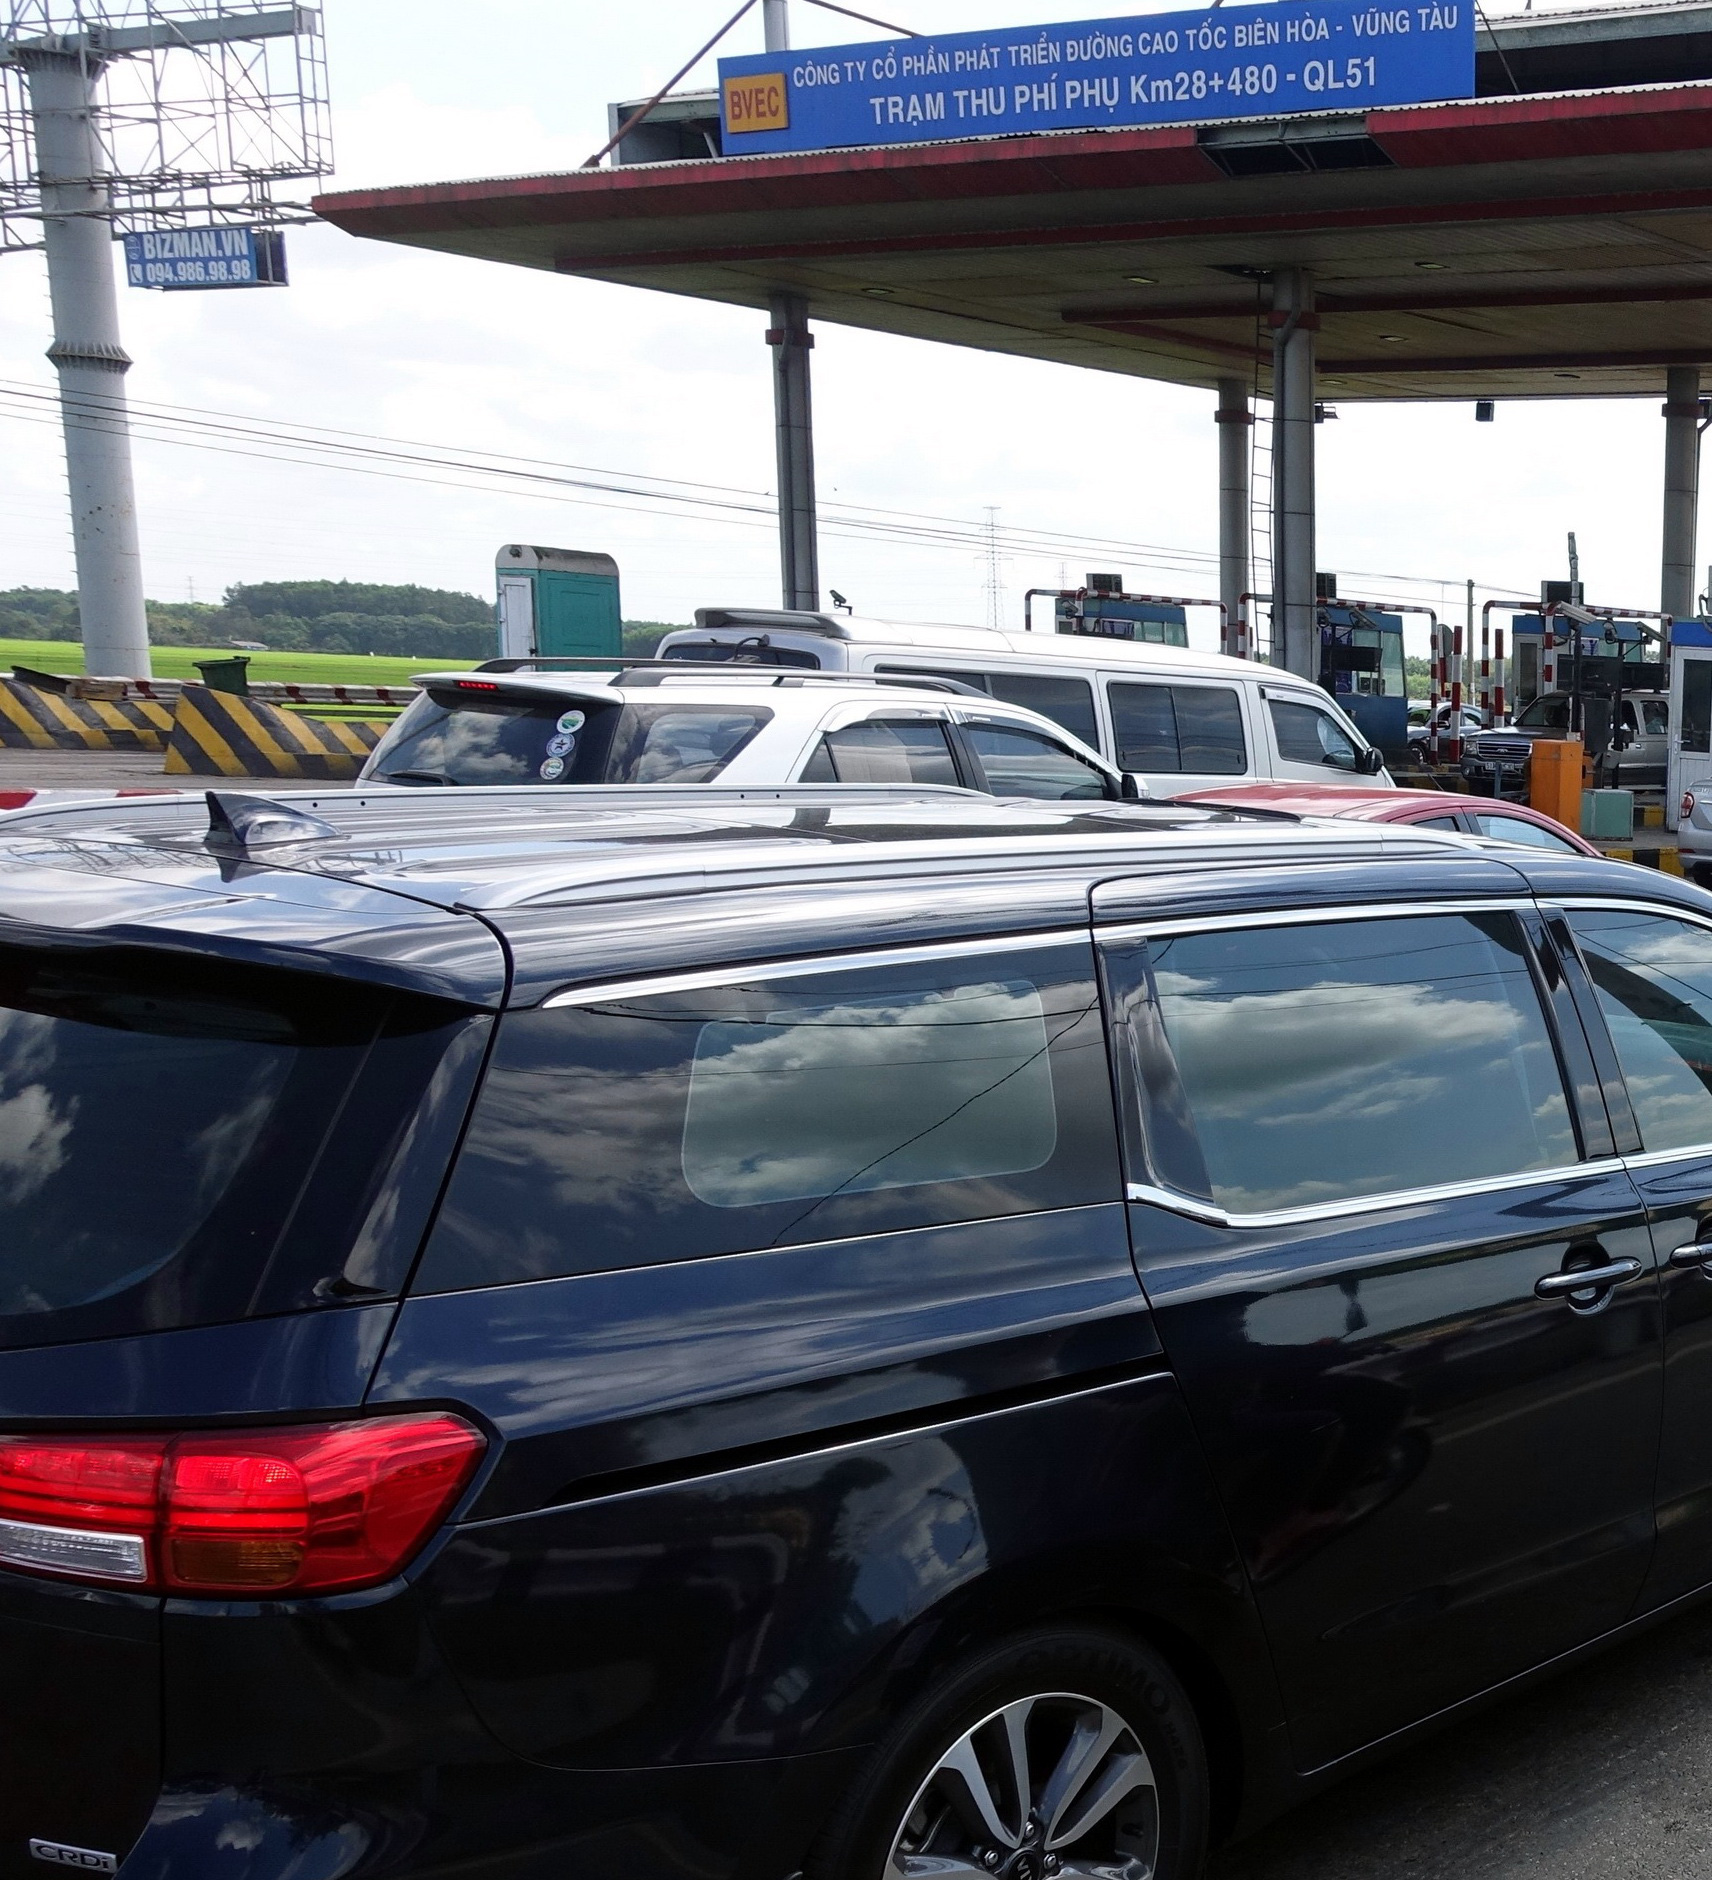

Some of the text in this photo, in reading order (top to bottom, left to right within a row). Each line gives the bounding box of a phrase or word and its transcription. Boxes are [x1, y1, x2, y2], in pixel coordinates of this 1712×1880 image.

[793, 60, 840, 88] CÔNG
[843, 61, 866, 83] TY
[872, 46, 897, 80] CỔ
[902, 45, 950, 78] PHẦN
[954, 43, 1001, 73] PHÁT
[1007, 32, 1060, 67] TRIỂN
[1066, 33, 1132, 62] ĐƯỜNG
[1138, 30, 1178, 55] CAO
[1185, 17, 1227, 51] TỐC
[1234, 18, 1280, 48] BIÊN
[1286, 13, 1330, 43] HÒA
[1352, 6, 1410, 37] VŨNG
[1417, 1, 1458, 31] TÀU
[730, 86, 780, 121] BVEC
[869, 92, 945, 127] TRẠM
[953, 86, 1005, 118] THU
[1014, 73, 1058, 114] PHÍ
[1065, 77, 1119, 113] PHỤ
[1130, 63, 1277, 105] Km28+480
[1303, 56, 1376, 93] QL51
[142, 229, 249, 259] BIZMAN.VN
[146, 259, 250, 283] 094.986.98.98
[35, 1845, 109, 1870] CRDi
